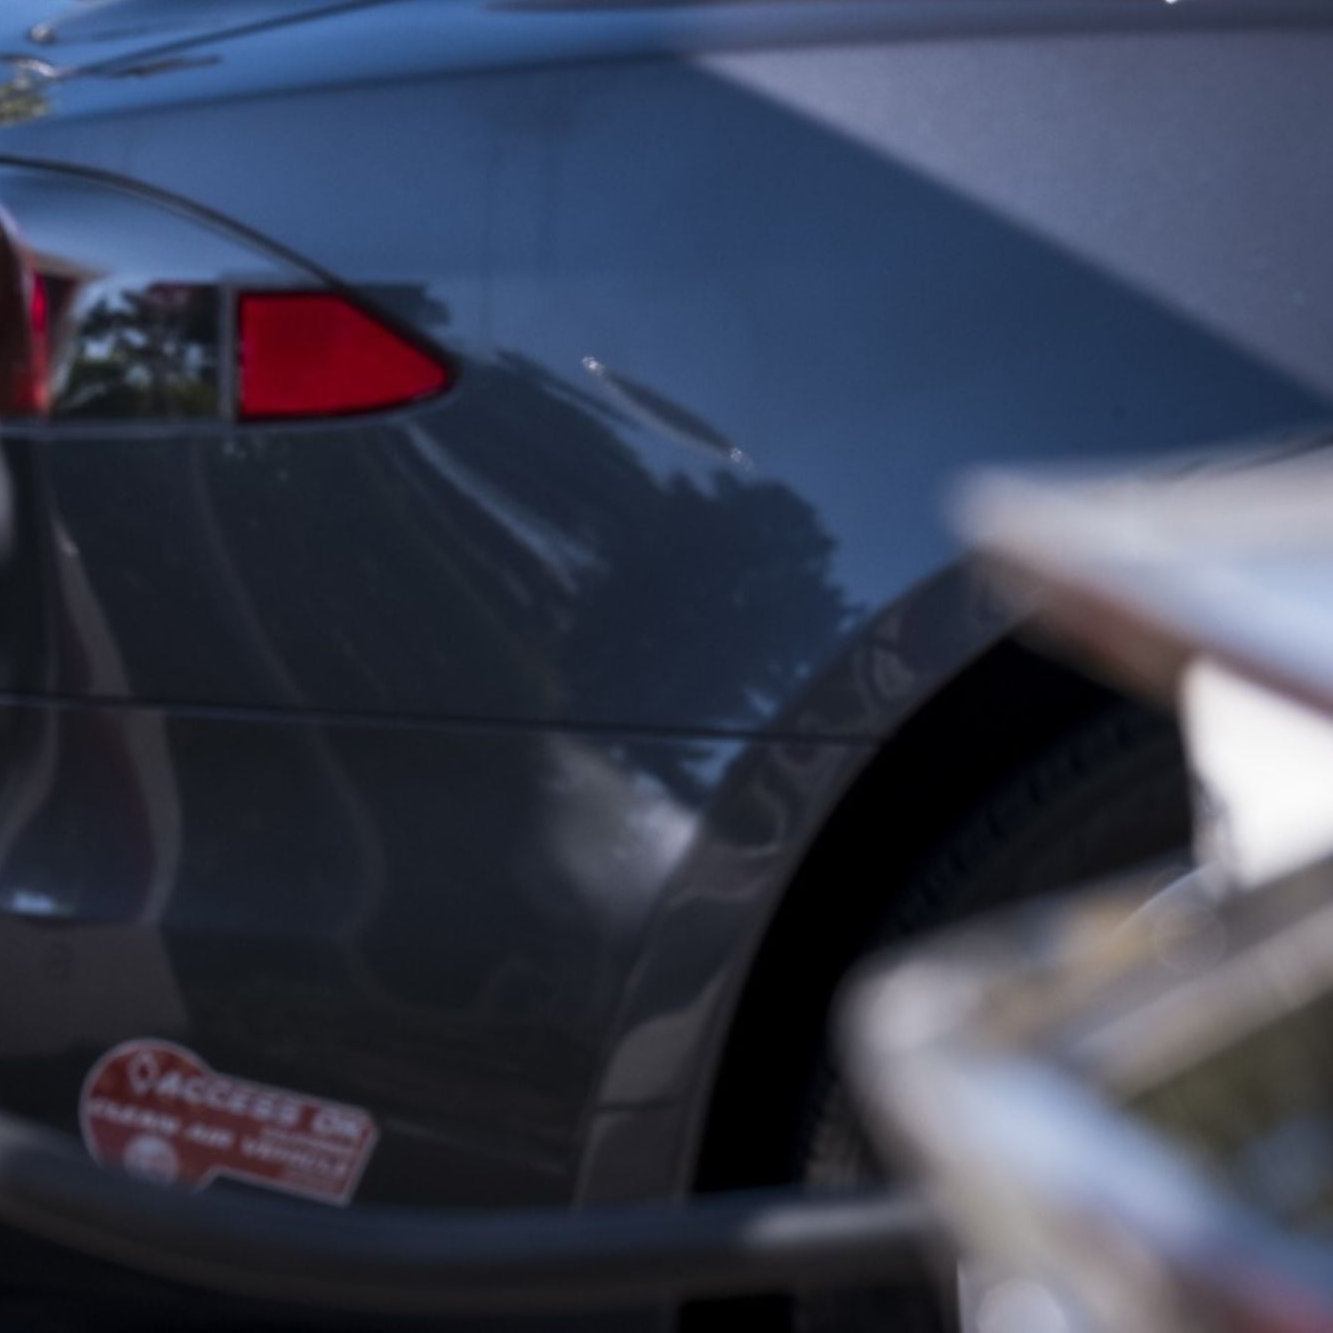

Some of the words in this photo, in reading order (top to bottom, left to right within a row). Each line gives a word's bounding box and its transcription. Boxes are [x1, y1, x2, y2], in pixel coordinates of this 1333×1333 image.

[86, 1097, 181, 1135] CLEAN
[183, 1123, 235, 1150] AIR
[155, 1070, 300, 1127] ACCESS
[310, 1106, 362, 1137] OK
